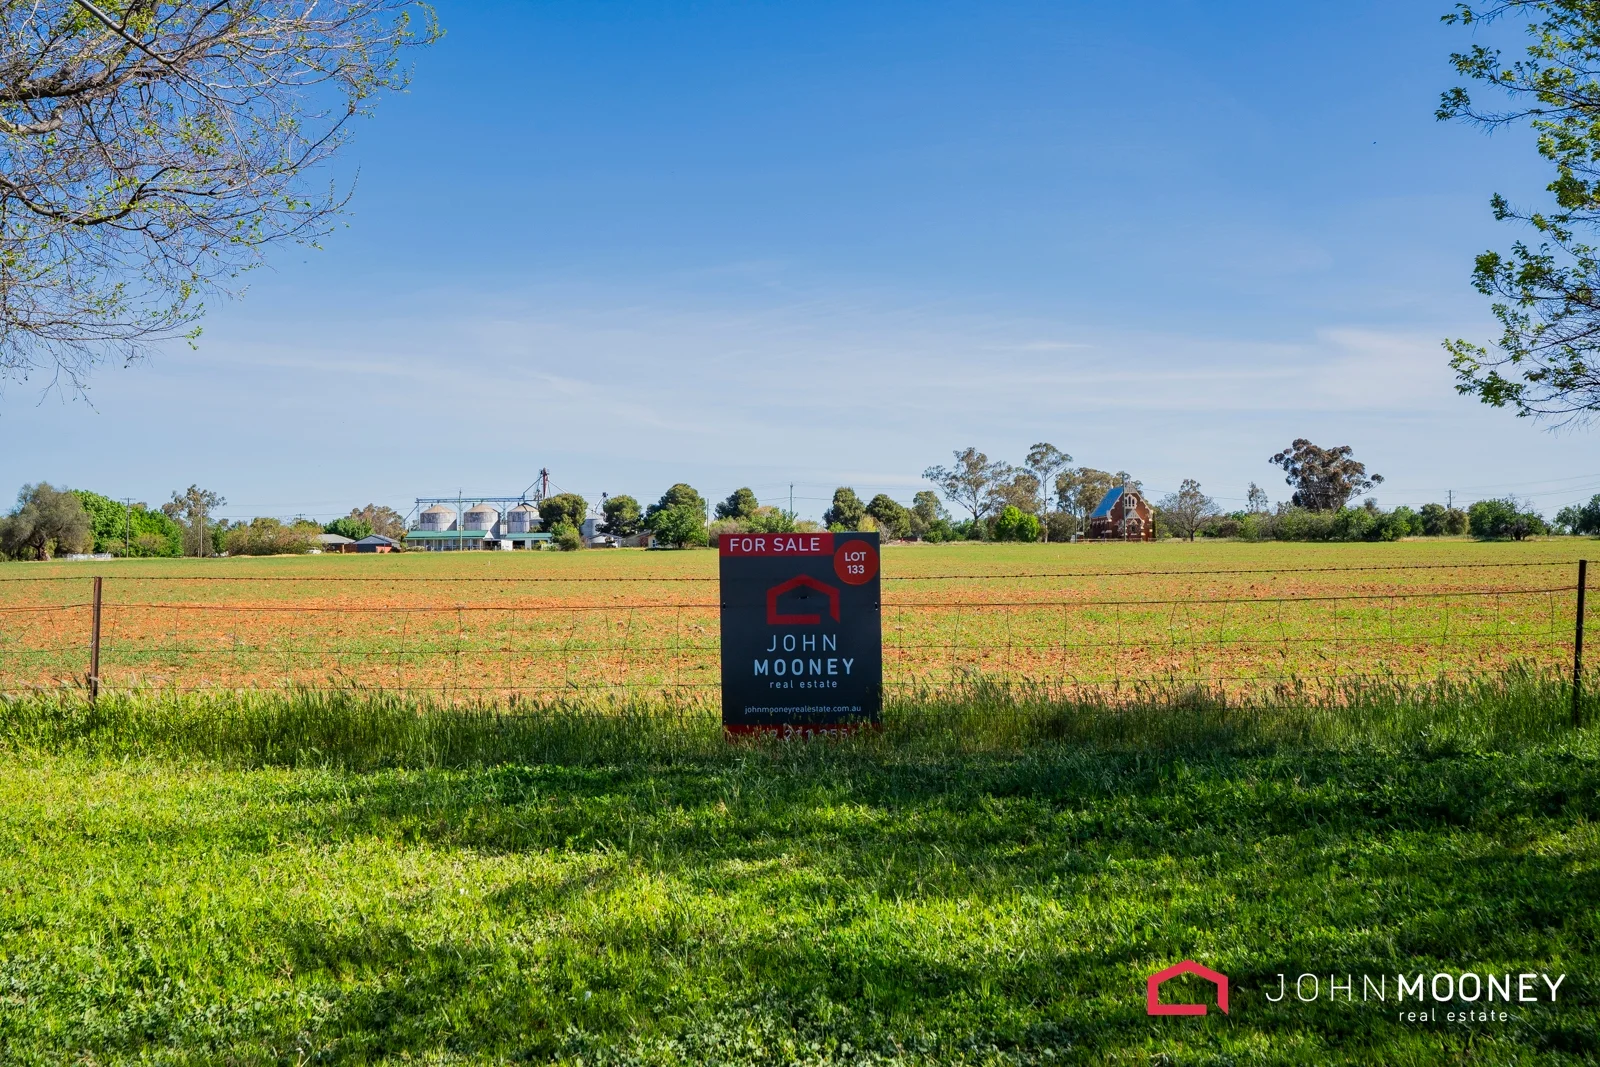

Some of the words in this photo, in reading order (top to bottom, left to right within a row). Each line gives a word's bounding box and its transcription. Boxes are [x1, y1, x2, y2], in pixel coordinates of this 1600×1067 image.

[730, 538, 766, 552] FOR
[773, 537, 821, 552] SALE
[844, 552, 867, 562] LOT
[847, 565, 865, 575] 133
[766, 634, 837, 652] JOHN
[753, 658, 854, 676] MOONEY
[769, 680, 794, 689] real
[799, 680, 838, 689] estate
[744, 703, 862, 715] johnmooneyrealestate.com.au
